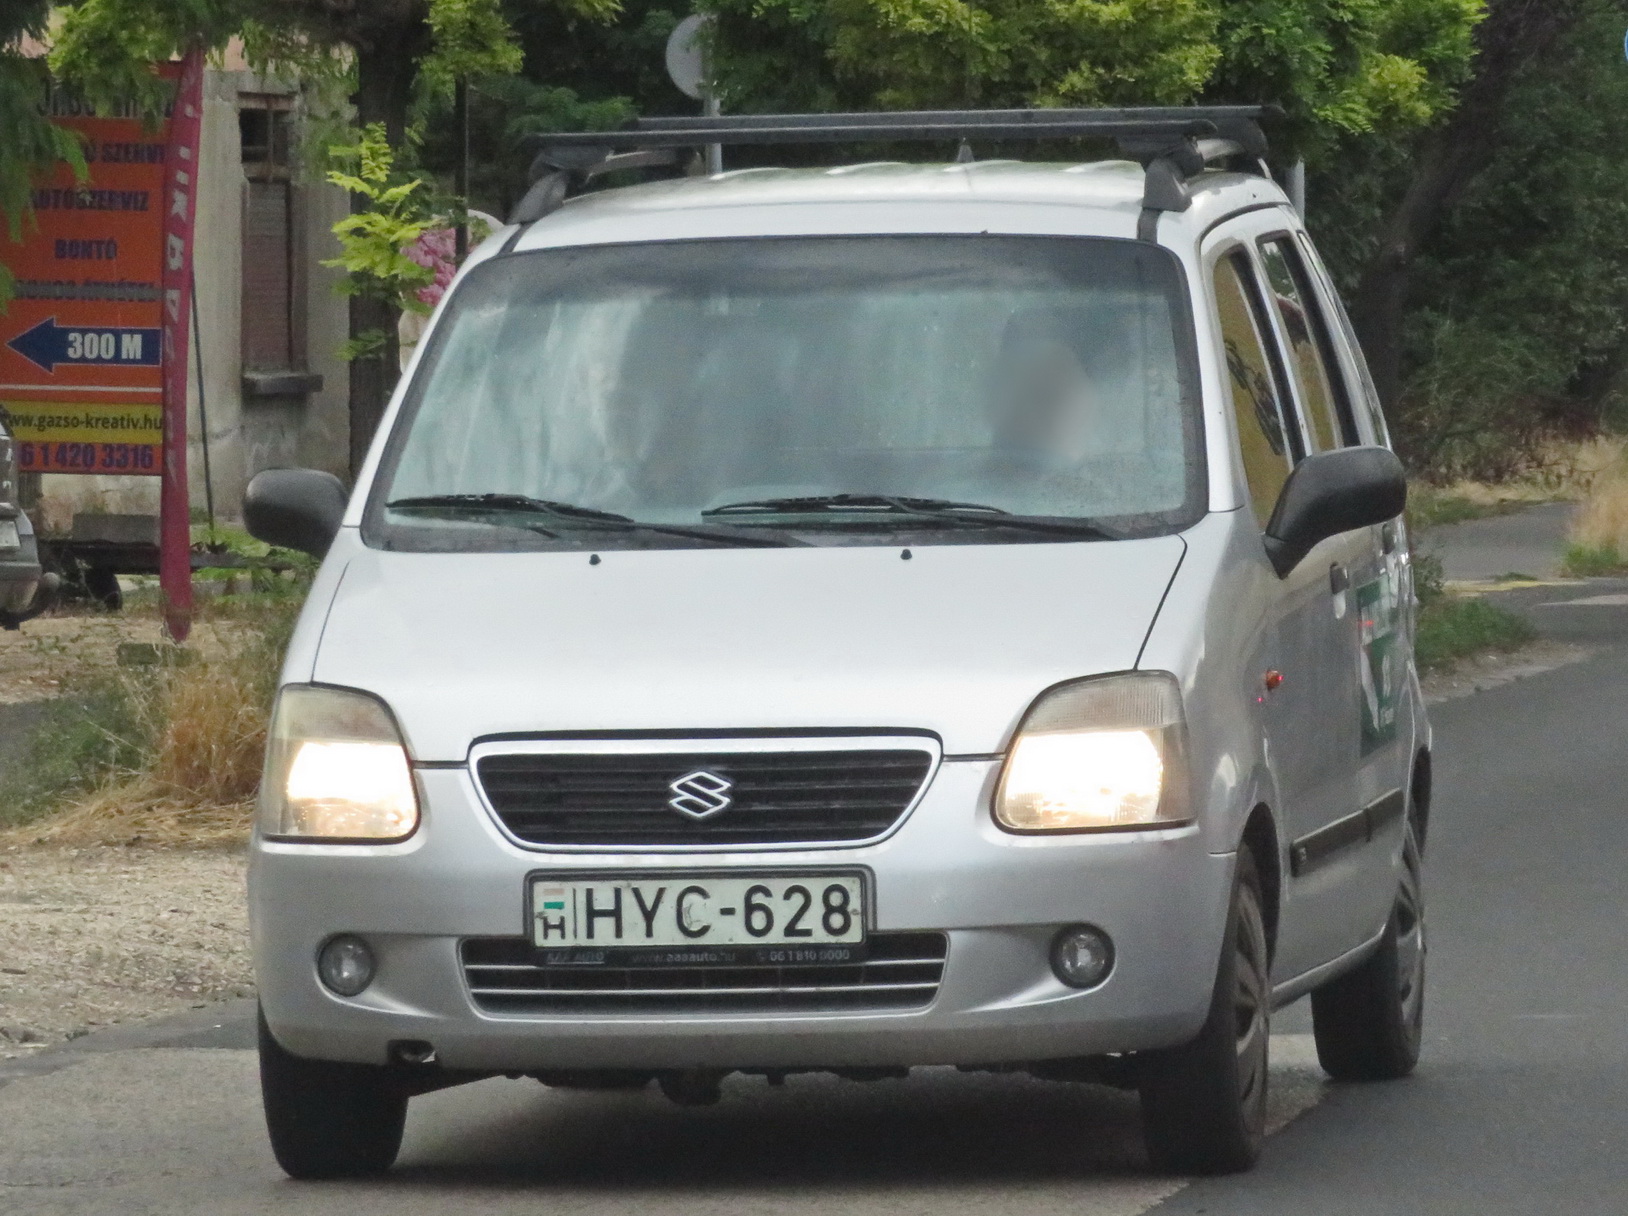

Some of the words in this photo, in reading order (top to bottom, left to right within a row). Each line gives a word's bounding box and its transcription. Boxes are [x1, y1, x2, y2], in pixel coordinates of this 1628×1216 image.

[67, 332, 116, 360] 300
[121, 333, 143, 360] M
[8, 412, 163, 432] ww.gazso-kreativ.hu
[20, 442, 35, 467] 6
[41, 443, 50, 467] 1
[55, 442, 97, 468] 420
[101, 443, 154, 469] 3316
[543, 915, 567, 940] H
[585, 883, 852, 940] HYC-628
